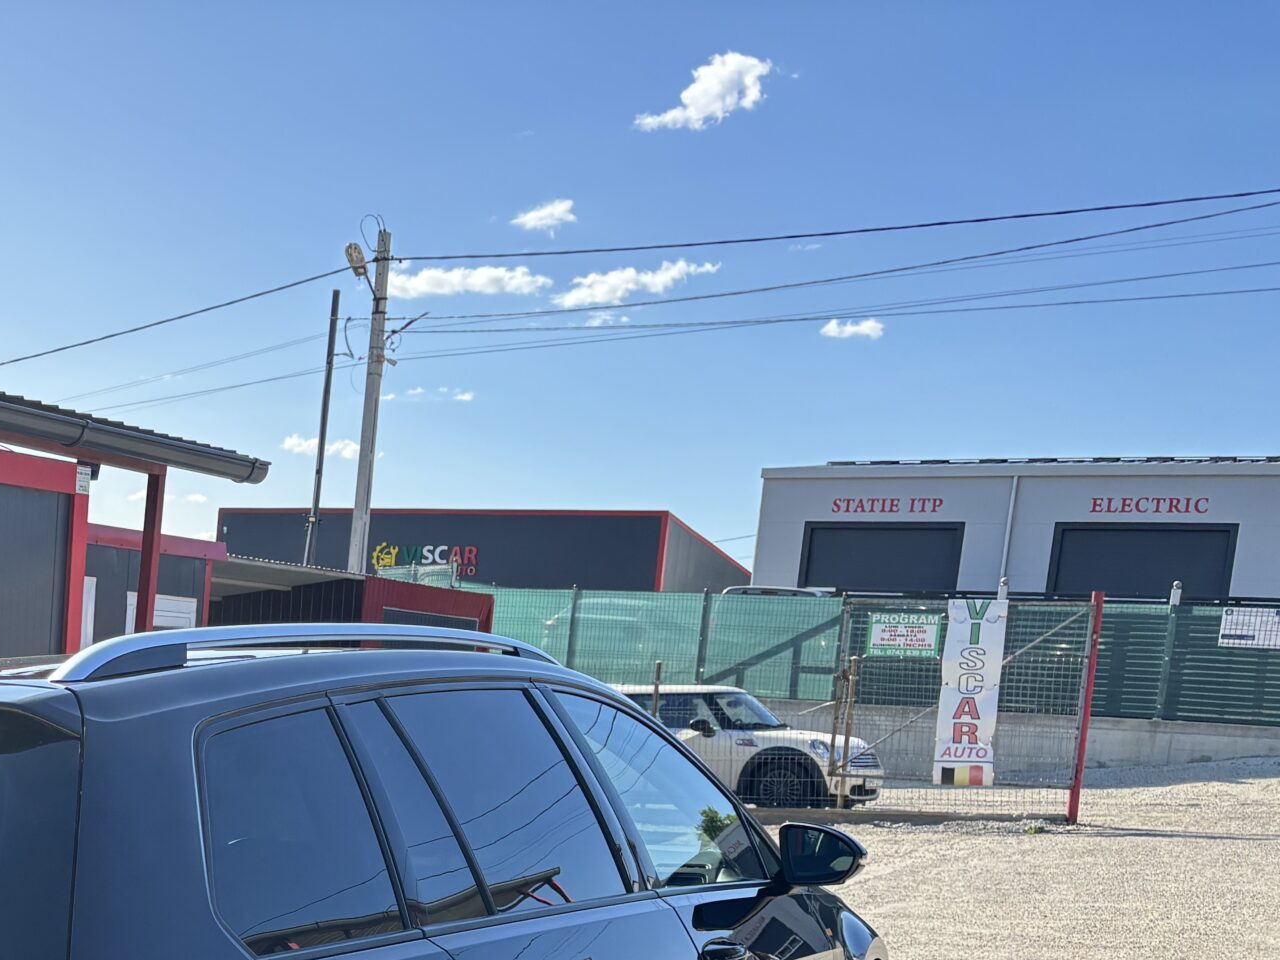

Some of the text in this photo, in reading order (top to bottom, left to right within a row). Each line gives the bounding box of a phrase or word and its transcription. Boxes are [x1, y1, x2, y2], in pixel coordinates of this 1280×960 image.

[832, 498, 944, 513] STATIE ITP
[1089, 497, 1210, 514] ELECTRIC
[402, 545, 478, 565] VISCAR
[872, 614, 939, 624] PROGRAM
[952, 600, 992, 744] VISCAR
[941, 746, 988, 759] AUTO
